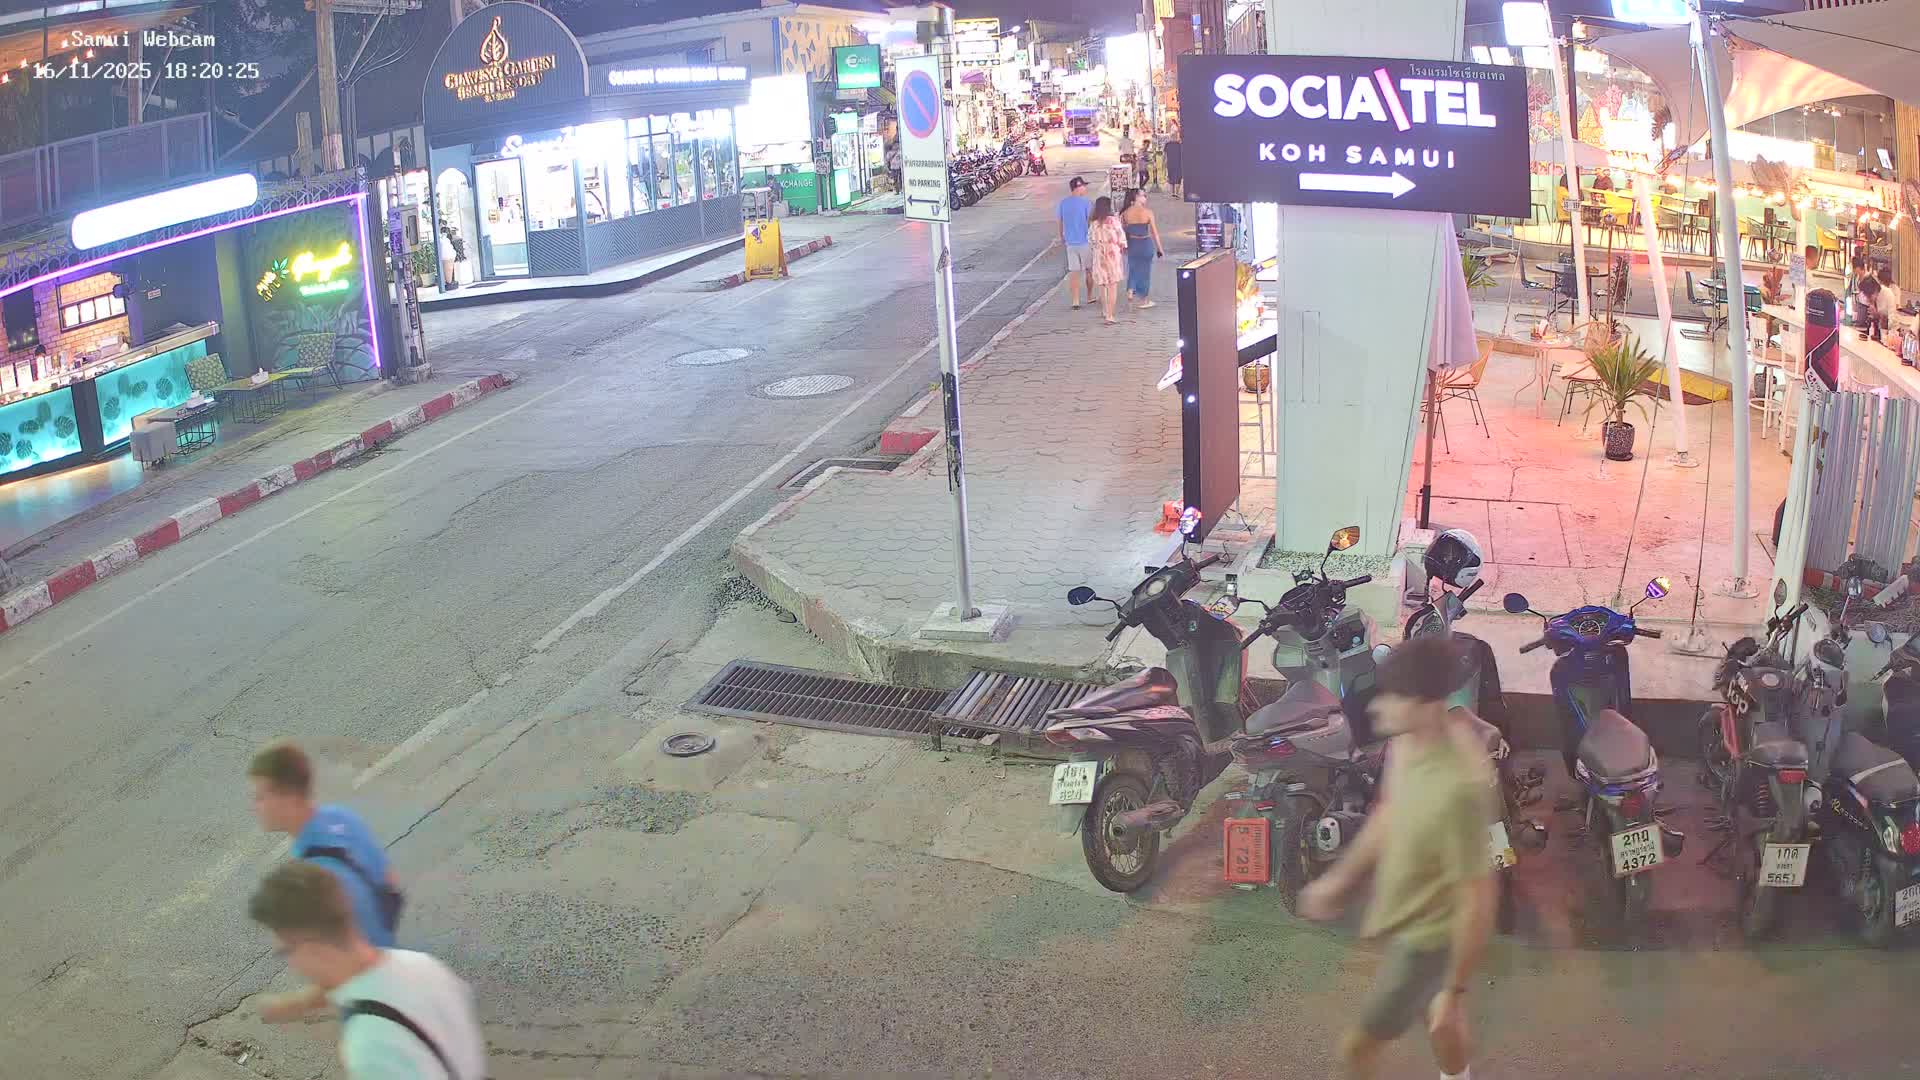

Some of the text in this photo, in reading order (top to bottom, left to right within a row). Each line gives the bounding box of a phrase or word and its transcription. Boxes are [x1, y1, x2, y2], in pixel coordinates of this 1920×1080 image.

[1259, 142, 1455, 169] KOH SAMUI
[908, 178, 941, 189] NO PARKING
[1622, 852, 1657, 871] 4372
